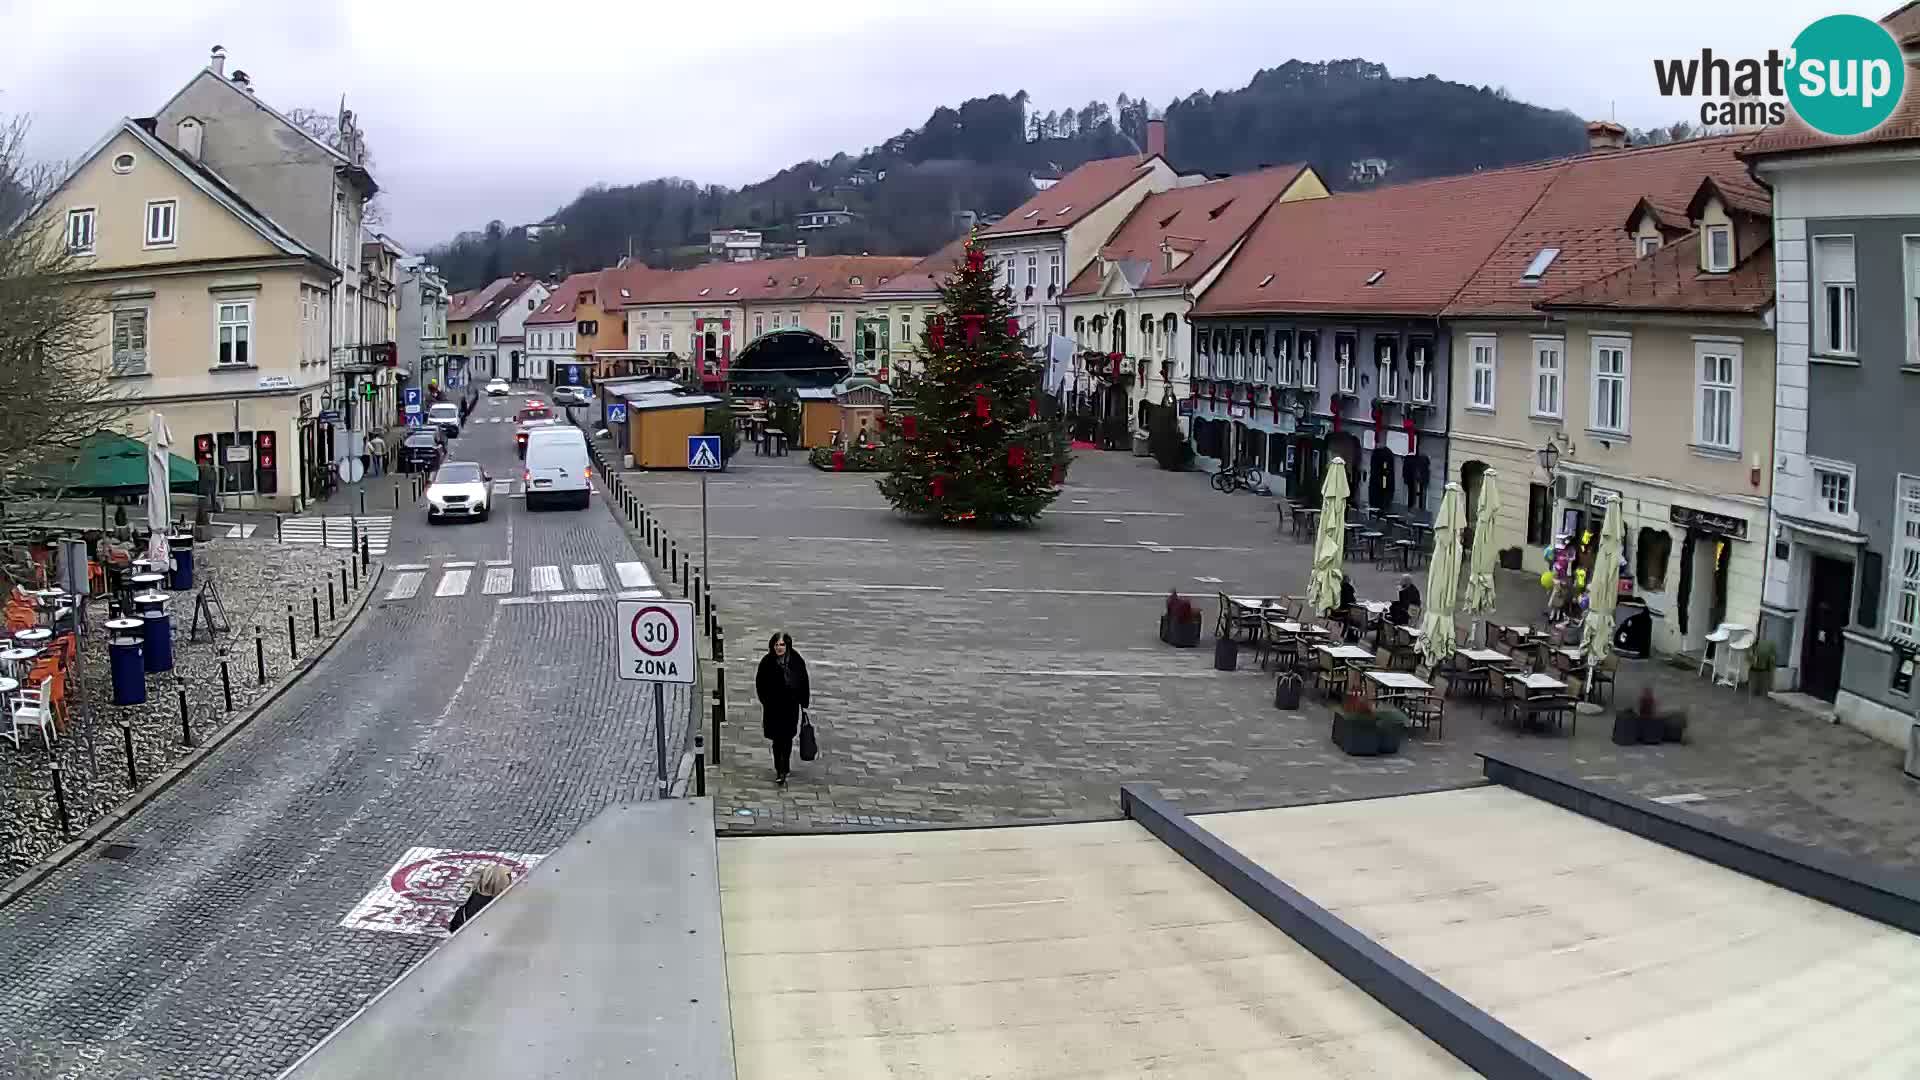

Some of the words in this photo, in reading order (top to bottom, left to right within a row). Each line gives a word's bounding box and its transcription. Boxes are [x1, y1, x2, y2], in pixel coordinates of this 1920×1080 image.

[408, 391, 417, 403] P
[643, 622, 668, 643] 30
[634, 659, 678, 676] ZONA
